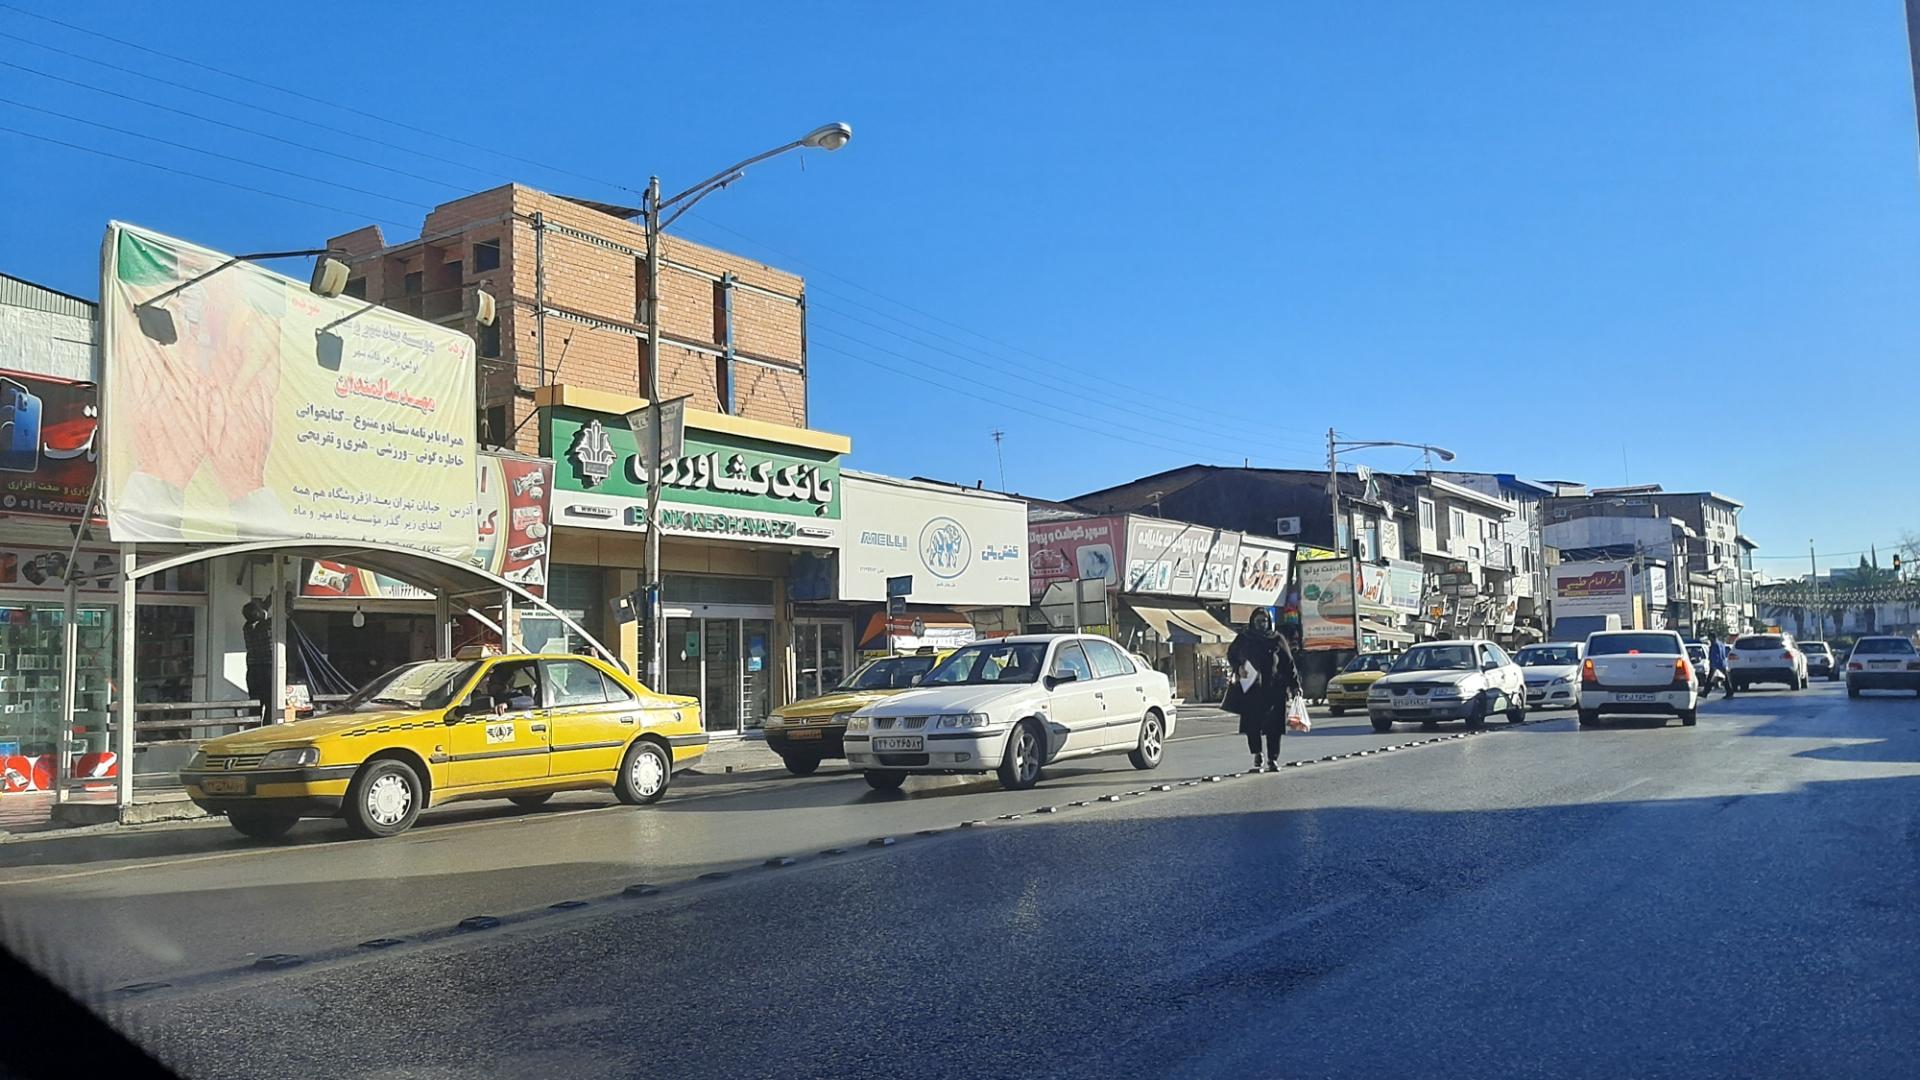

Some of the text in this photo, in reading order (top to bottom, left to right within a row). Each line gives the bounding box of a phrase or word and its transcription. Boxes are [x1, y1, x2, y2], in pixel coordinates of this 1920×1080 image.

[335, 376, 400, 405] سالمندان
[296, 402, 344, 425] کتابخوانی
[387, 421, 410, 436] شاد
[297, 429, 335, 448] تفریحی
[343, 436, 368, 452] هنری
[442, 431, 464, 447] همراه
[376, 442, 408, 460] ورزشی
[438, 453, 464, 468] خاطره
[770, 462, 833, 517] بانک
[373, 495, 392, 507] بعد
[392, 494, 415, 509] تهران
[416, 498, 440, 512] خیابان
[293, 505, 307, 517] ماه
[317, 509, 333, 521] مهر
[384, 514, 400, 528] گذر
[405, 518, 417, 530] زیر
[417, 520, 442, 532] ابتدای
[631, 505, 797, 537] BNK KESHAVARZI
[860, 531, 908, 548] MELLI
[981, 544, 1019, 561] کفش ملی
